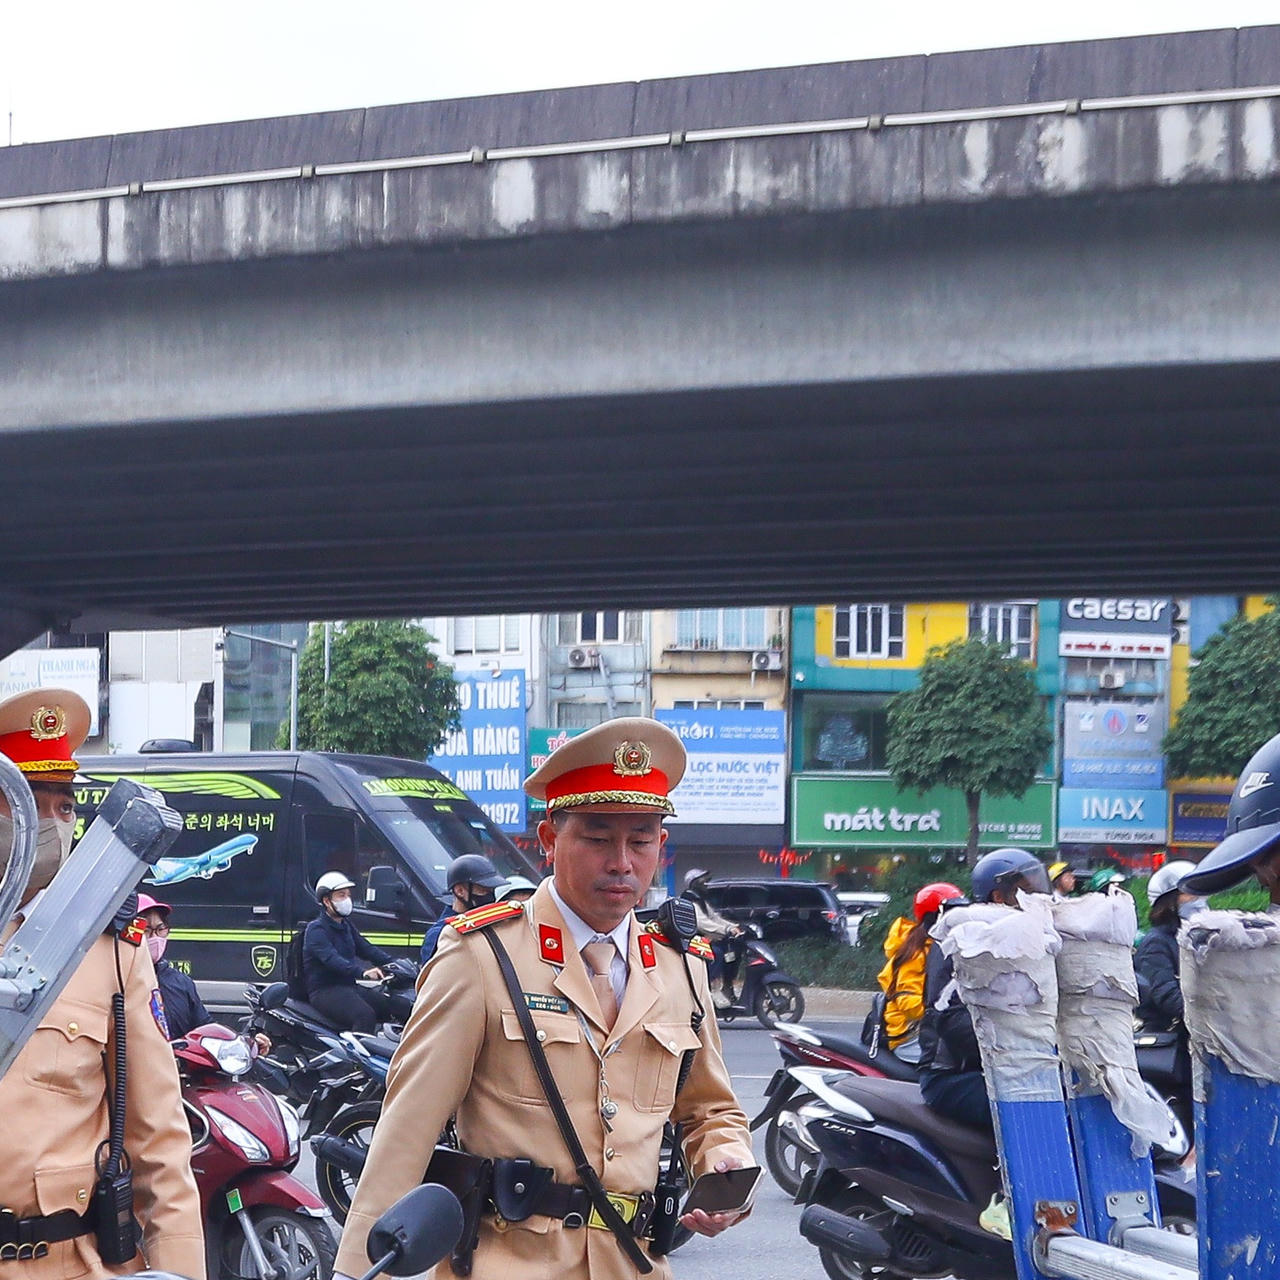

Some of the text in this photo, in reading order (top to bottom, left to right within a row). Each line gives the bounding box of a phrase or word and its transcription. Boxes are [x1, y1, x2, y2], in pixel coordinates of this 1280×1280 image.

[475, 674, 521, 711] THUÊ
[473, 724, 520, 757] HÀNG
[455, 769, 483, 791] ANH
[823, 806, 886, 832] mát
[1081, 796, 1145, 821] INAX
